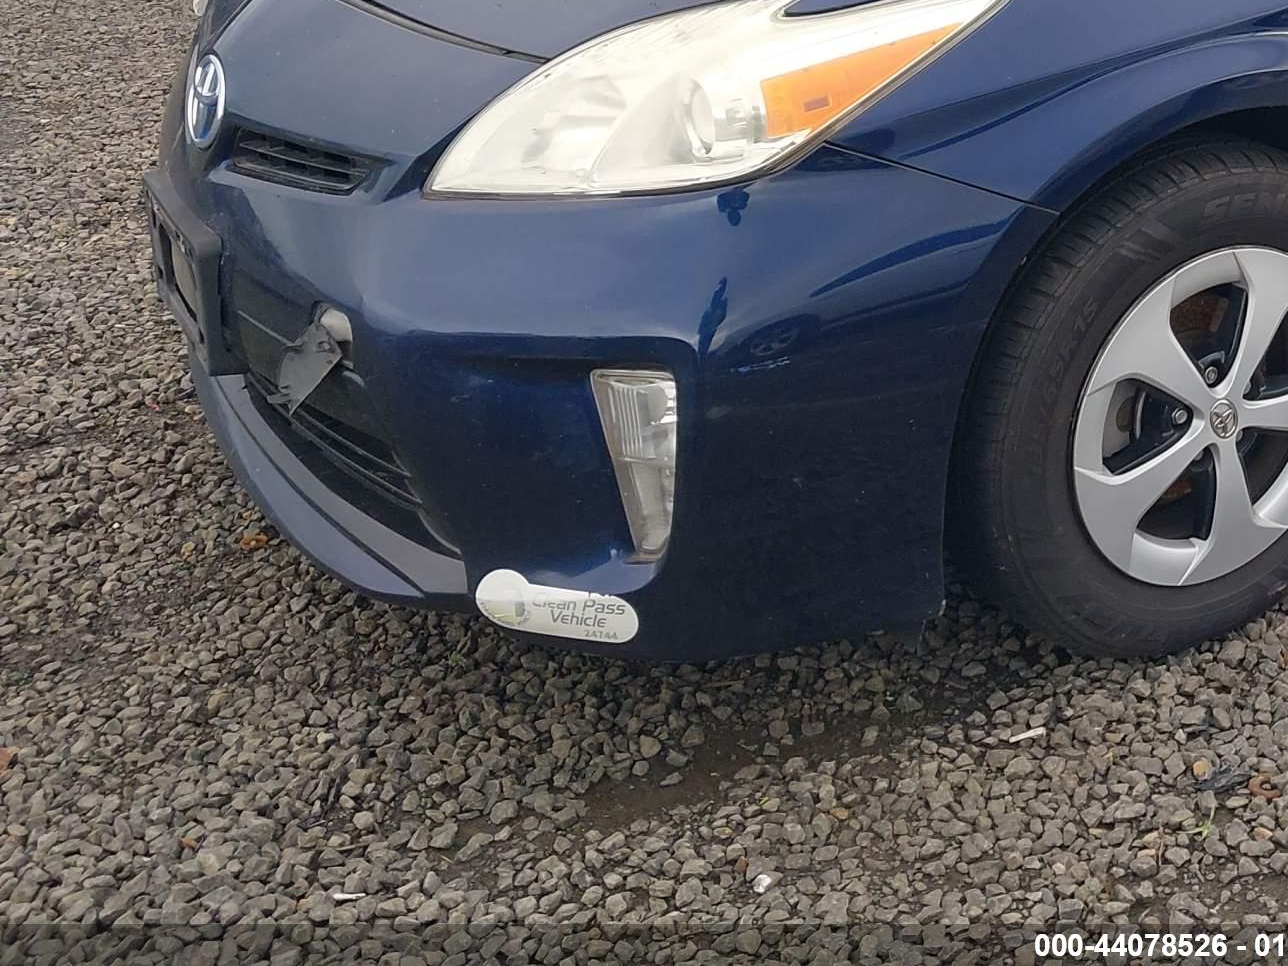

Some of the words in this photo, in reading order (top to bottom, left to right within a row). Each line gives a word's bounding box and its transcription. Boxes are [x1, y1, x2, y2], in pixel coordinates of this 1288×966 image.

[531, 594, 577, 611] Clean
[582, 599, 626, 616] Pass
[550, 610, 607, 628] Vehicle
